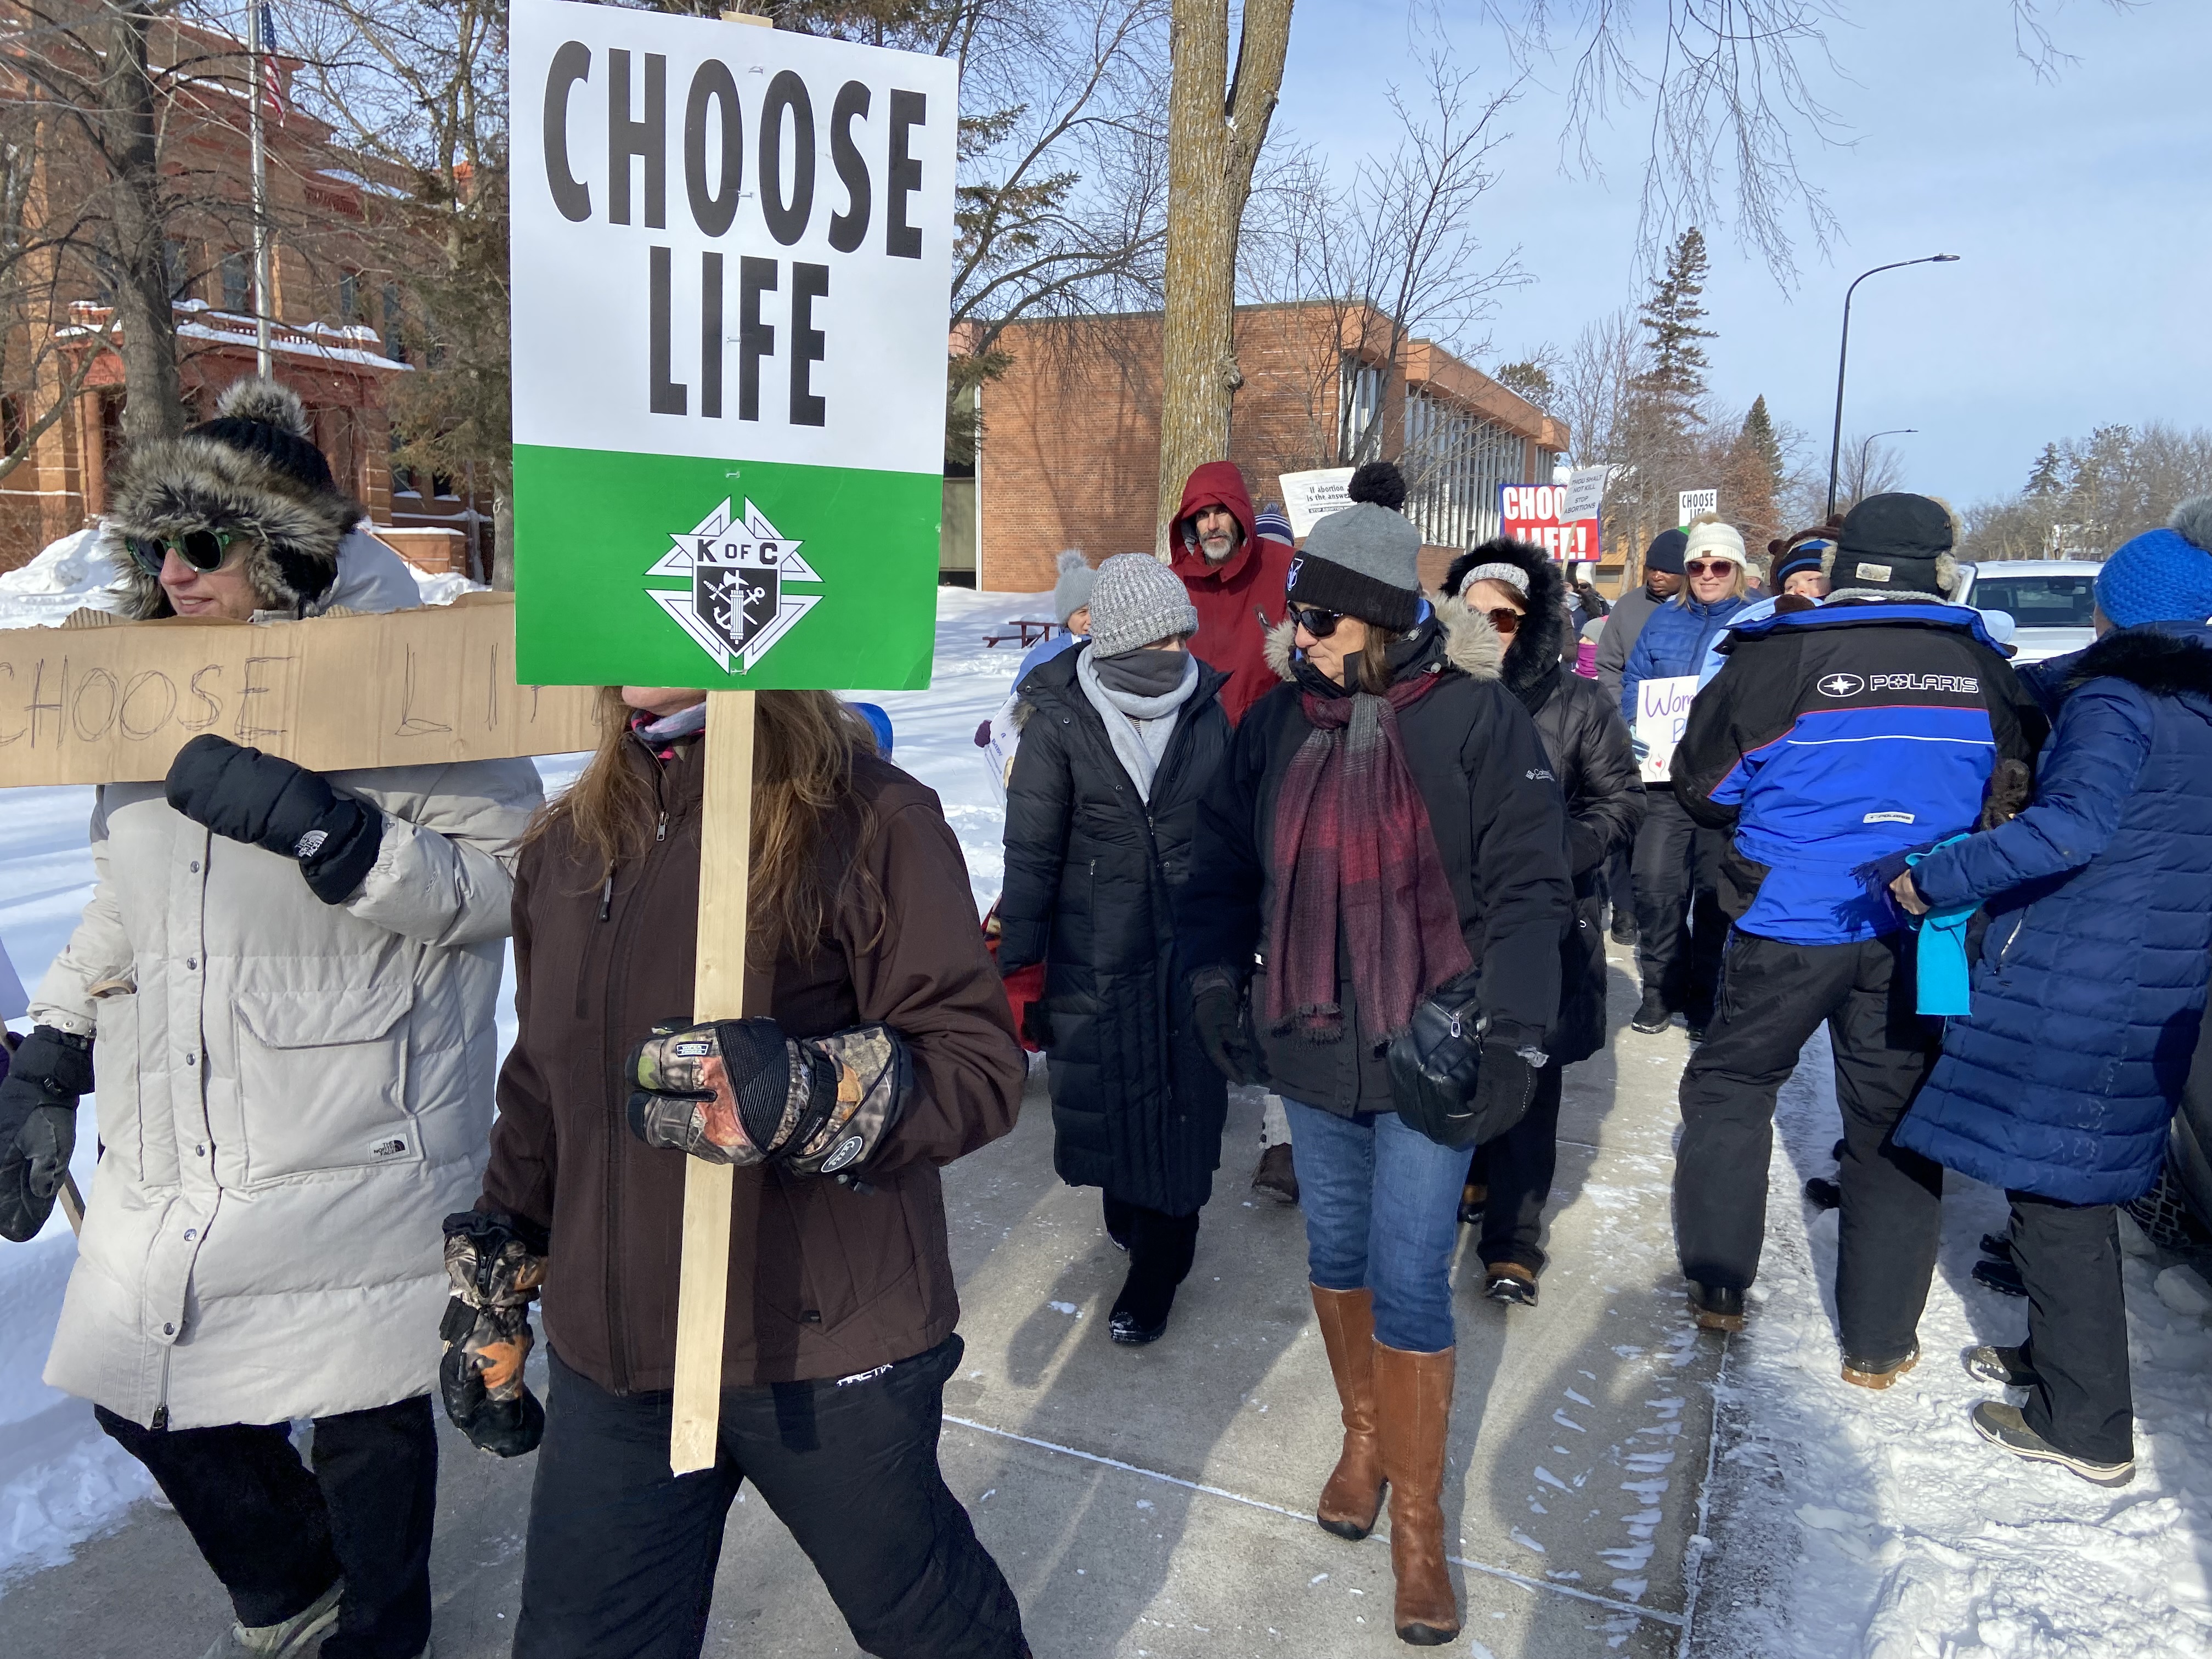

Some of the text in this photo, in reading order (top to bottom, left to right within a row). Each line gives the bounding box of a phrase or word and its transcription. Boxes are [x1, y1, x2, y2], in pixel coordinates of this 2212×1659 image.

[544, 40, 926, 259] CHOOSE
[650, 246, 829, 427] LIFE
[1585, 475, 1603, 483] SHALT
[1503, 486, 1597, 520] CHOO
[1564, 503, 1596, 514] ABORTIONS
[1575, 495, 1589, 504] STOP
[1682, 493, 1713, 508] CHOOSE
[697, 539, 777, 565] K OF C
[1870, 673, 1979, 693] POLARIS
